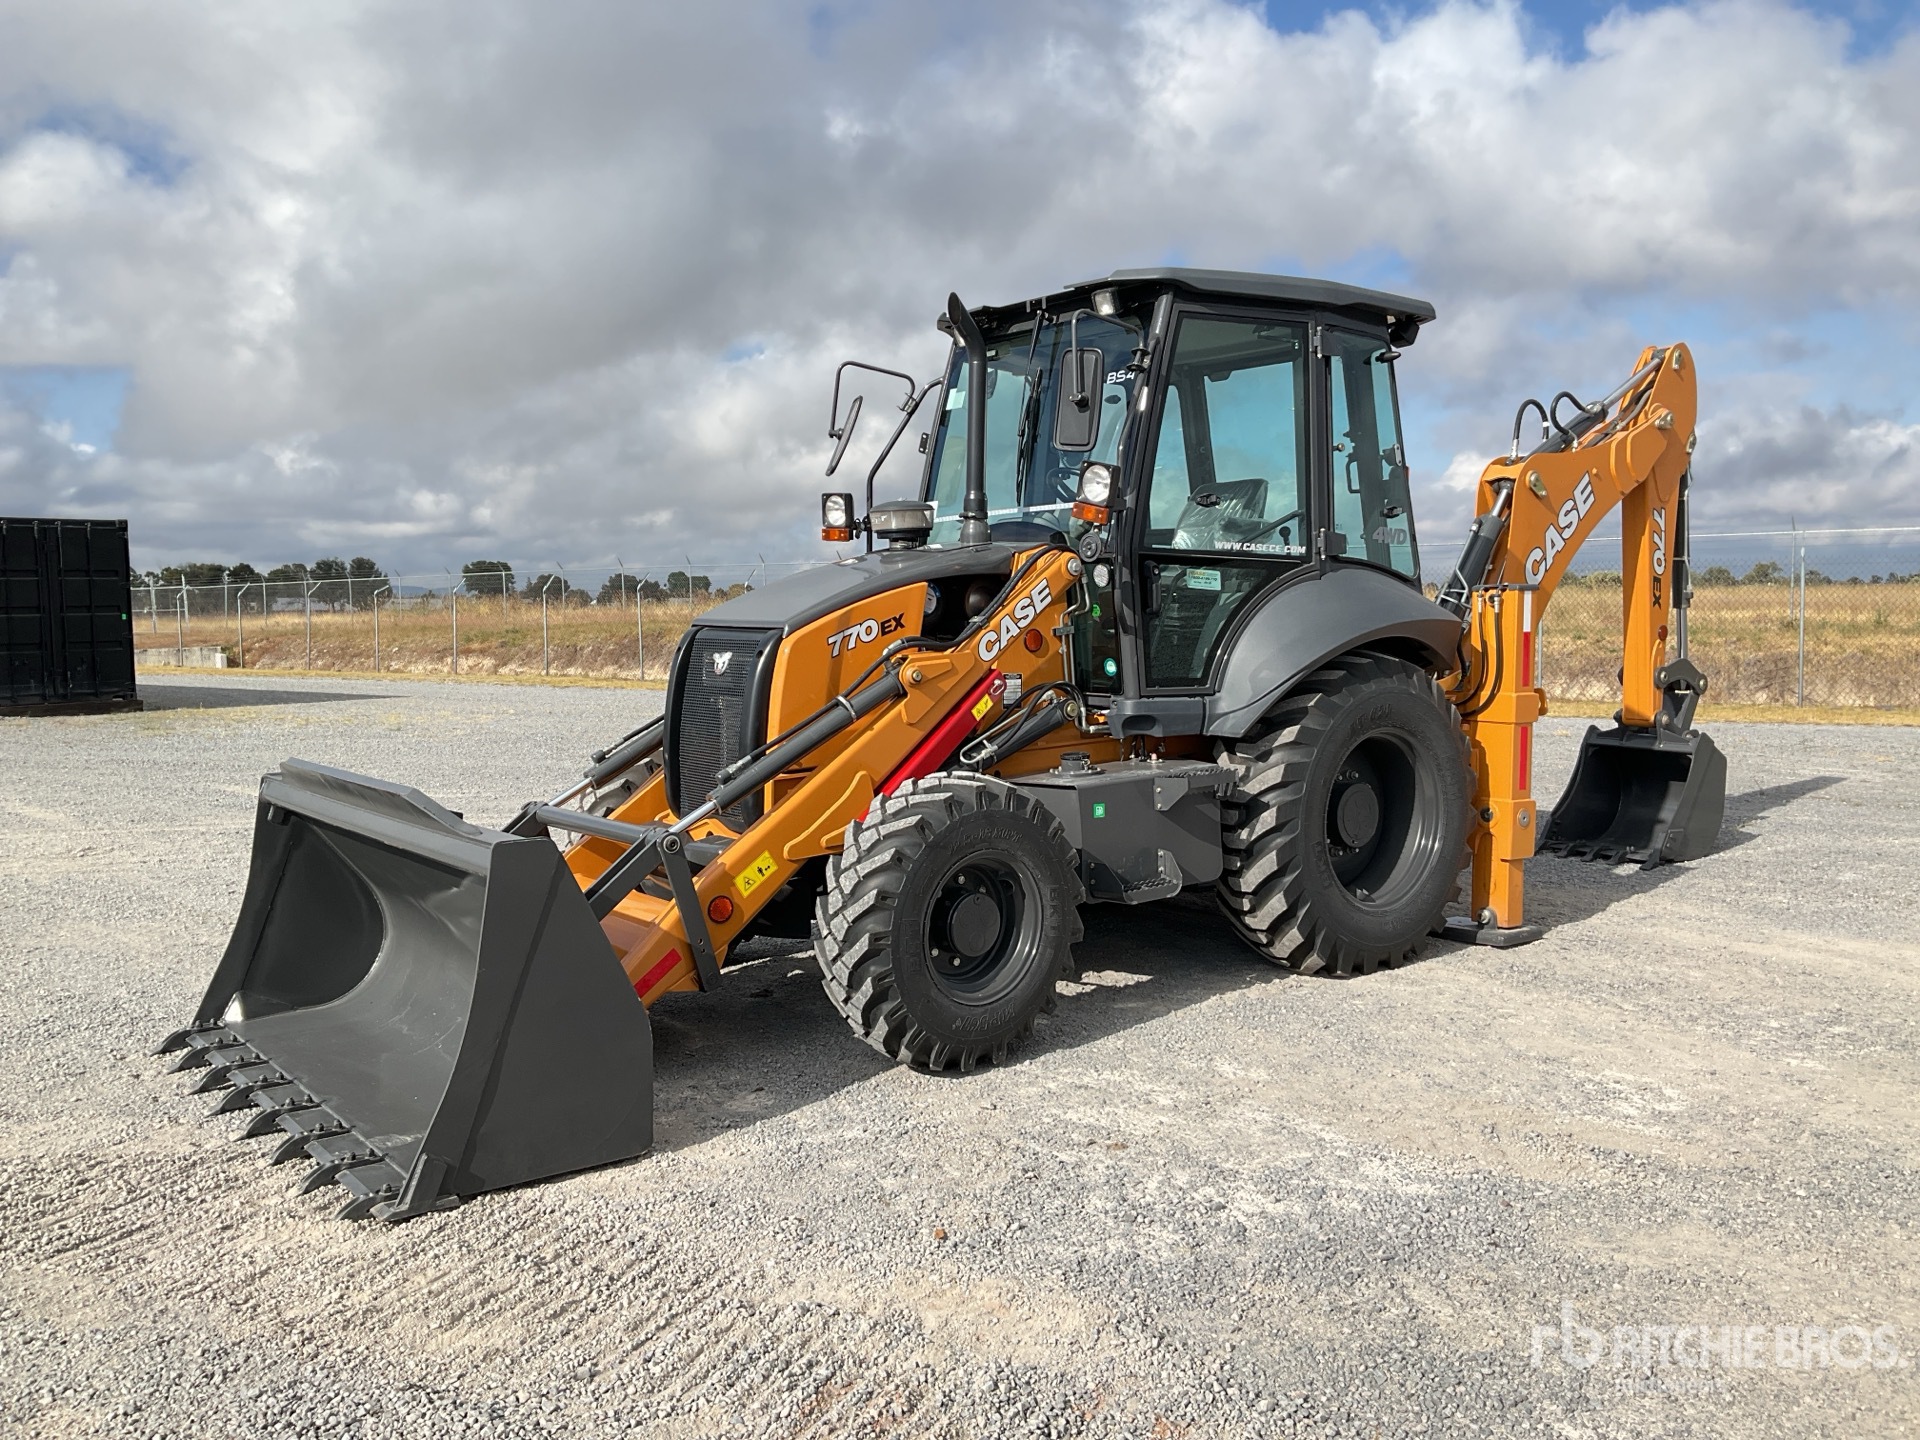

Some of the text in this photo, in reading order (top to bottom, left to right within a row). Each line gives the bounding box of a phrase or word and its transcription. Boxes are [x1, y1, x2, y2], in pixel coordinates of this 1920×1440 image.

[1372, 526, 1407, 545] 4WD
[1525, 471, 1595, 585] CASE
[978, 577, 1052, 662] CASE
